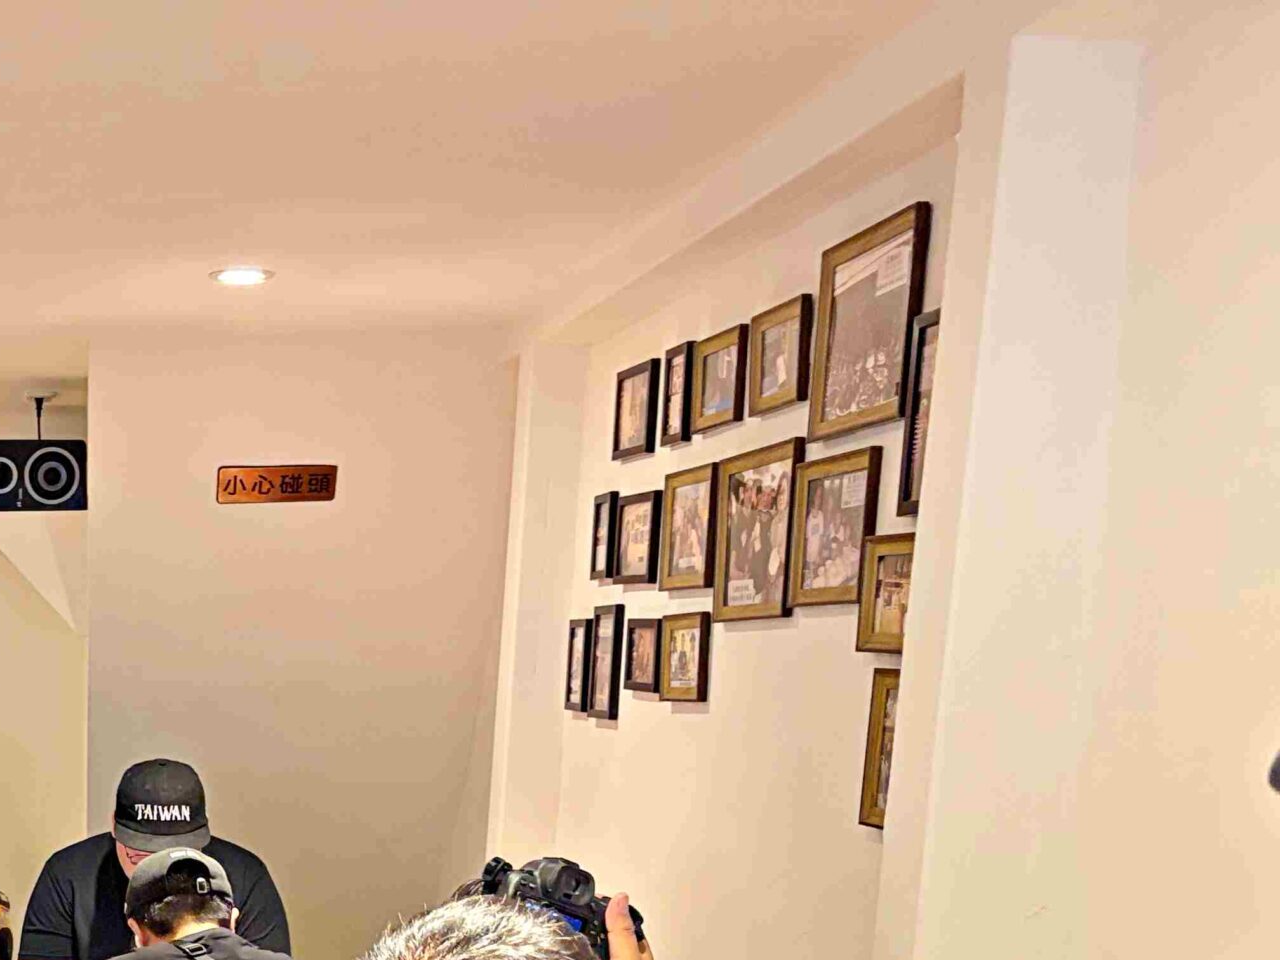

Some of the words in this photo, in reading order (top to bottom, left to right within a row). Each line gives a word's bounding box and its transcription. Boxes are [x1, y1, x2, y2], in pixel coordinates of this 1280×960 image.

[223, 473, 333, 496] 小心碰頭
[134, 803, 191, 822] TAIWAN
